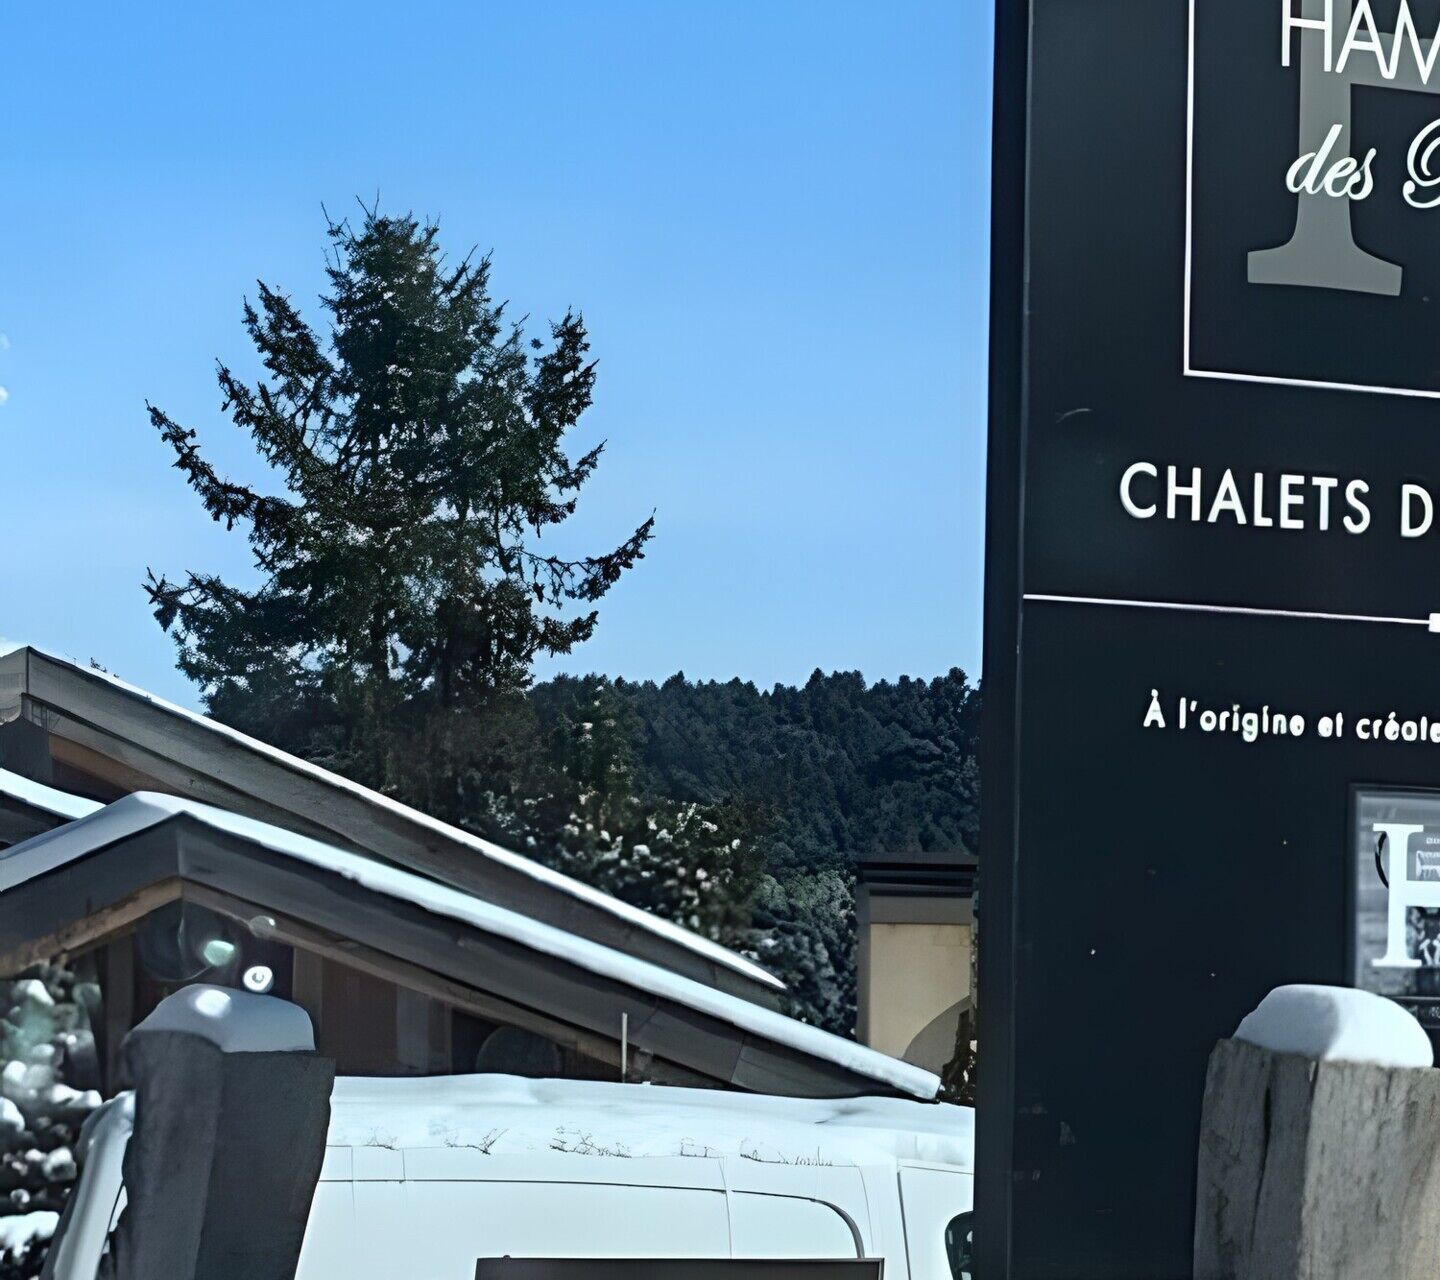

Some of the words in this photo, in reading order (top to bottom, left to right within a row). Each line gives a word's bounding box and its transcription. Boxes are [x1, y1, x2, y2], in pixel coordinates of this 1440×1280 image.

[1285, 123, 1377, 201] des
[1118, 460, 1372, 535] CHALETS
[1317, 711, 1344, 738] et
